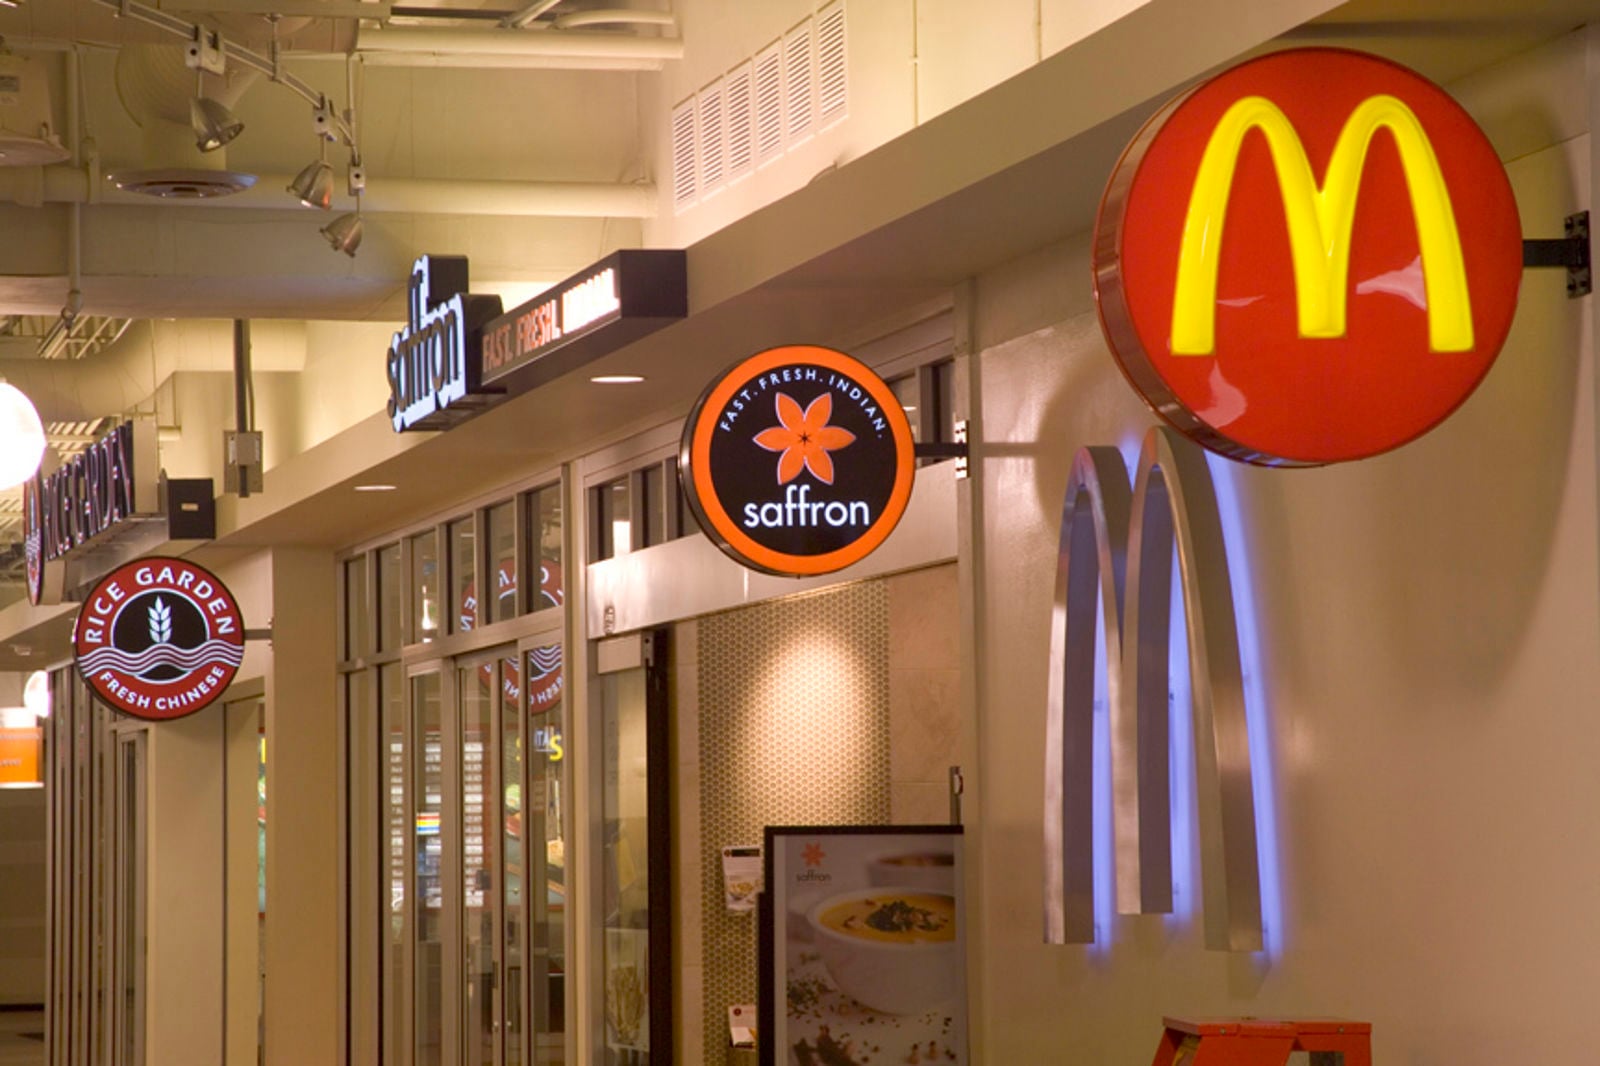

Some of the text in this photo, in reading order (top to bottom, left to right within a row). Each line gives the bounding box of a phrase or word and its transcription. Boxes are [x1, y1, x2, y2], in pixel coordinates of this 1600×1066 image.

[743, 484, 870, 527] saffron
[85, 566, 235, 643] RICE GARDEN
[100, 666, 225, 710] FRESH CHINESE
